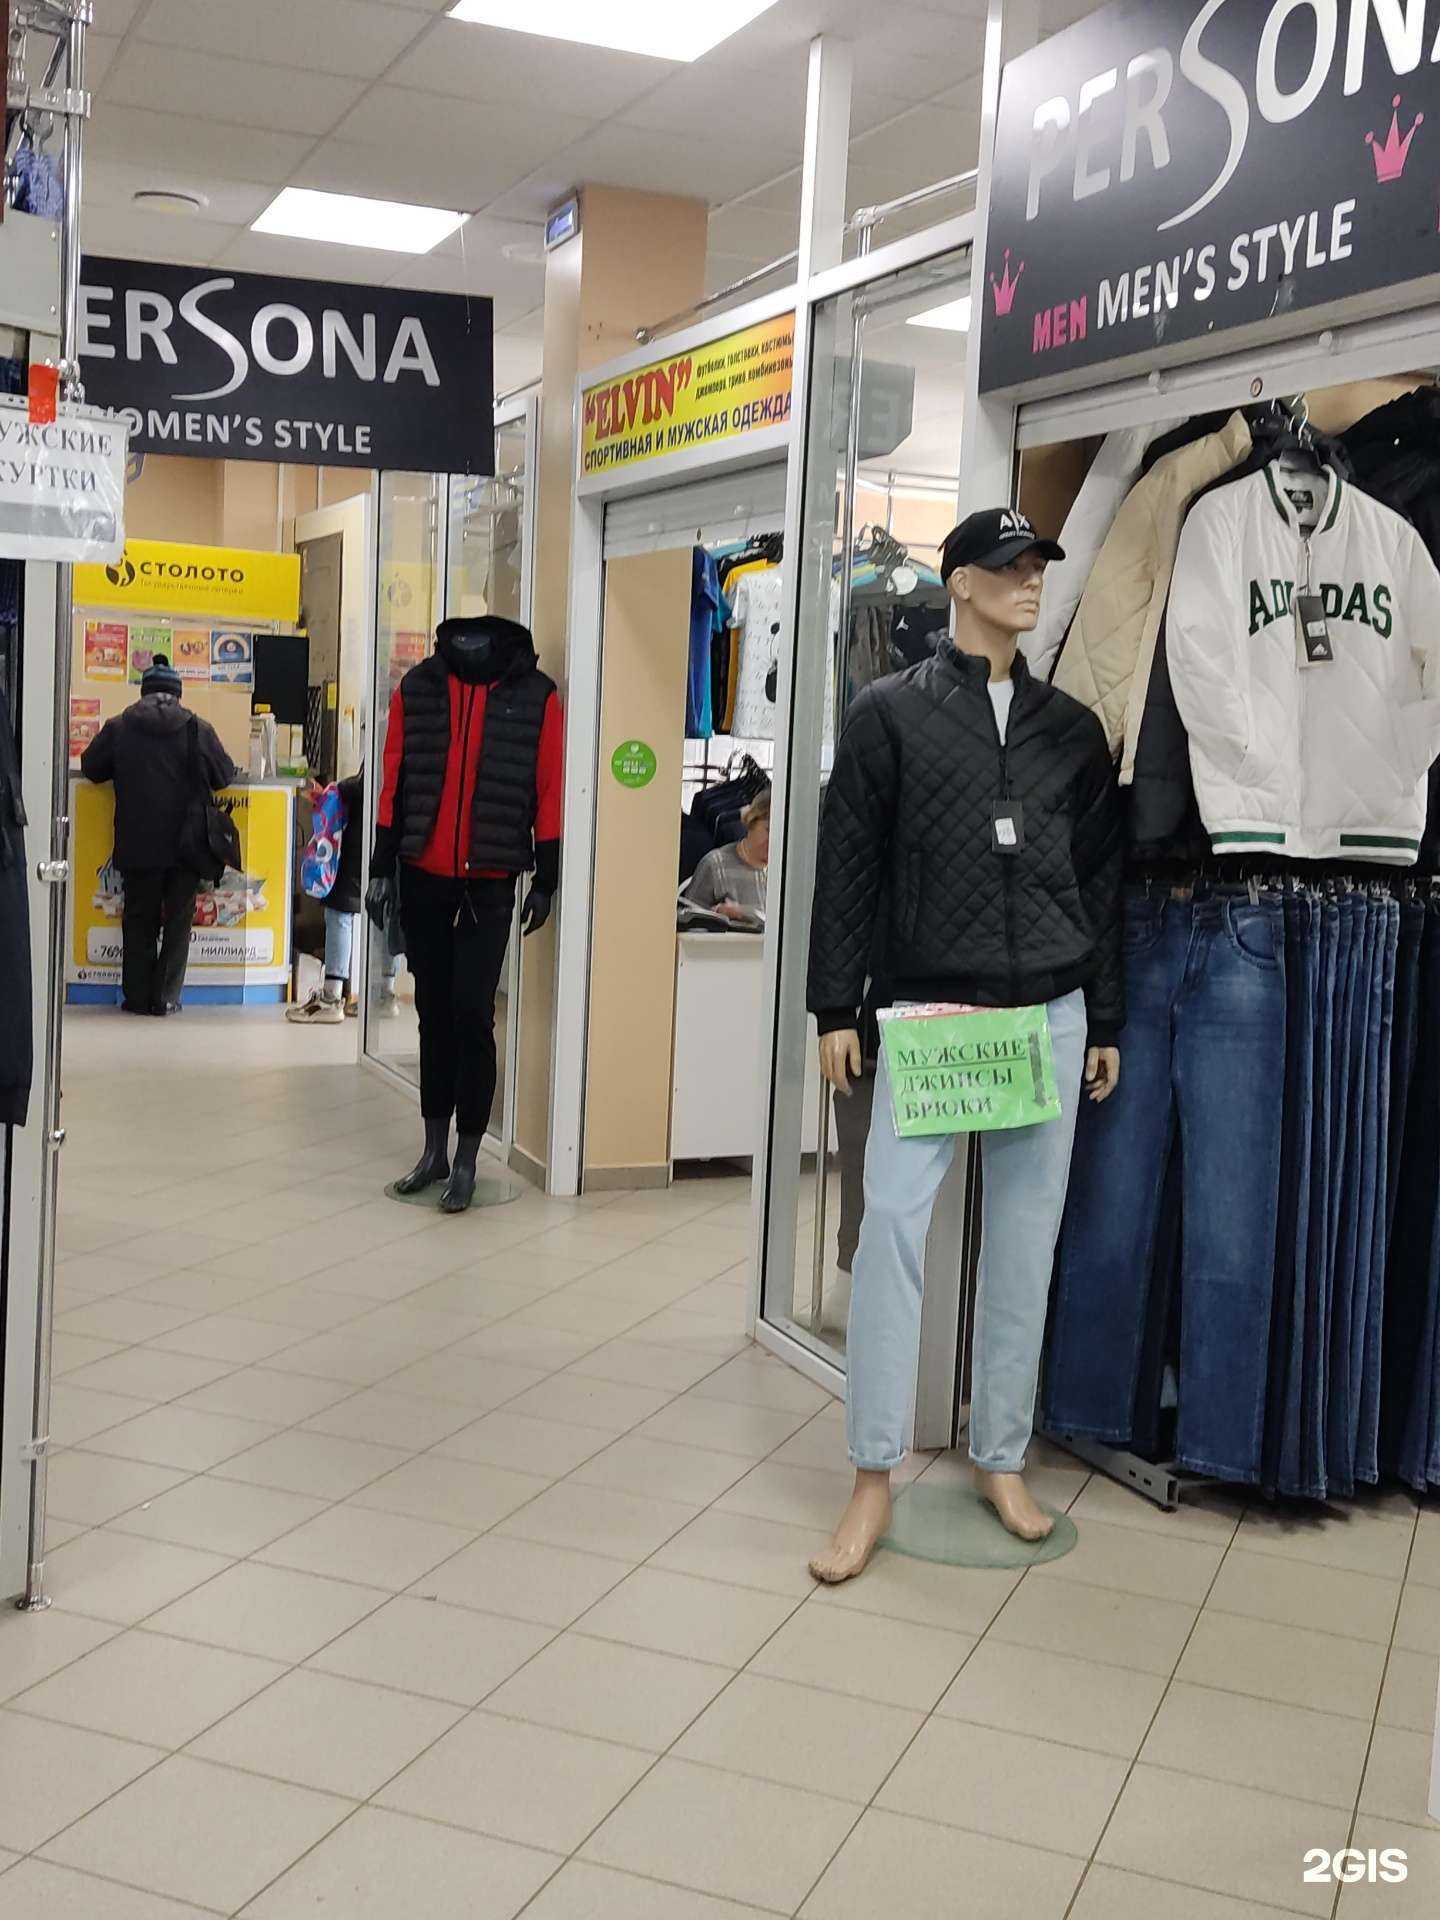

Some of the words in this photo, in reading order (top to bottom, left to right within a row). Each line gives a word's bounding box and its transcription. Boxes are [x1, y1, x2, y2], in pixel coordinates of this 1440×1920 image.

[1025, 0, 1440, 232] PERSON
[1031, 296, 1088, 354] MEN
[1096, 244, 1217, 331] MEN'S
[1227, 198, 1357, 293] STYLE
[77, 277, 441, 401] ERSONA
[0, 420, 112, 456] УЖСКИЕ
[273, 418, 373, 455] STYLE
[584, 432, 652, 472] СПОРТИВНАЯ
[655, 429, 665, 451] И
[667, 411, 728, 446] МУЖСКАЯ
[732, 391, 792, 433] ОДЕЖДА
[898, 1037, 1026, 1067] МУЖСКИЕ
[900, 1067, 1014, 1097] ДЖИНСЫ
[904, 1096, 993, 1120] БРЮКИ
